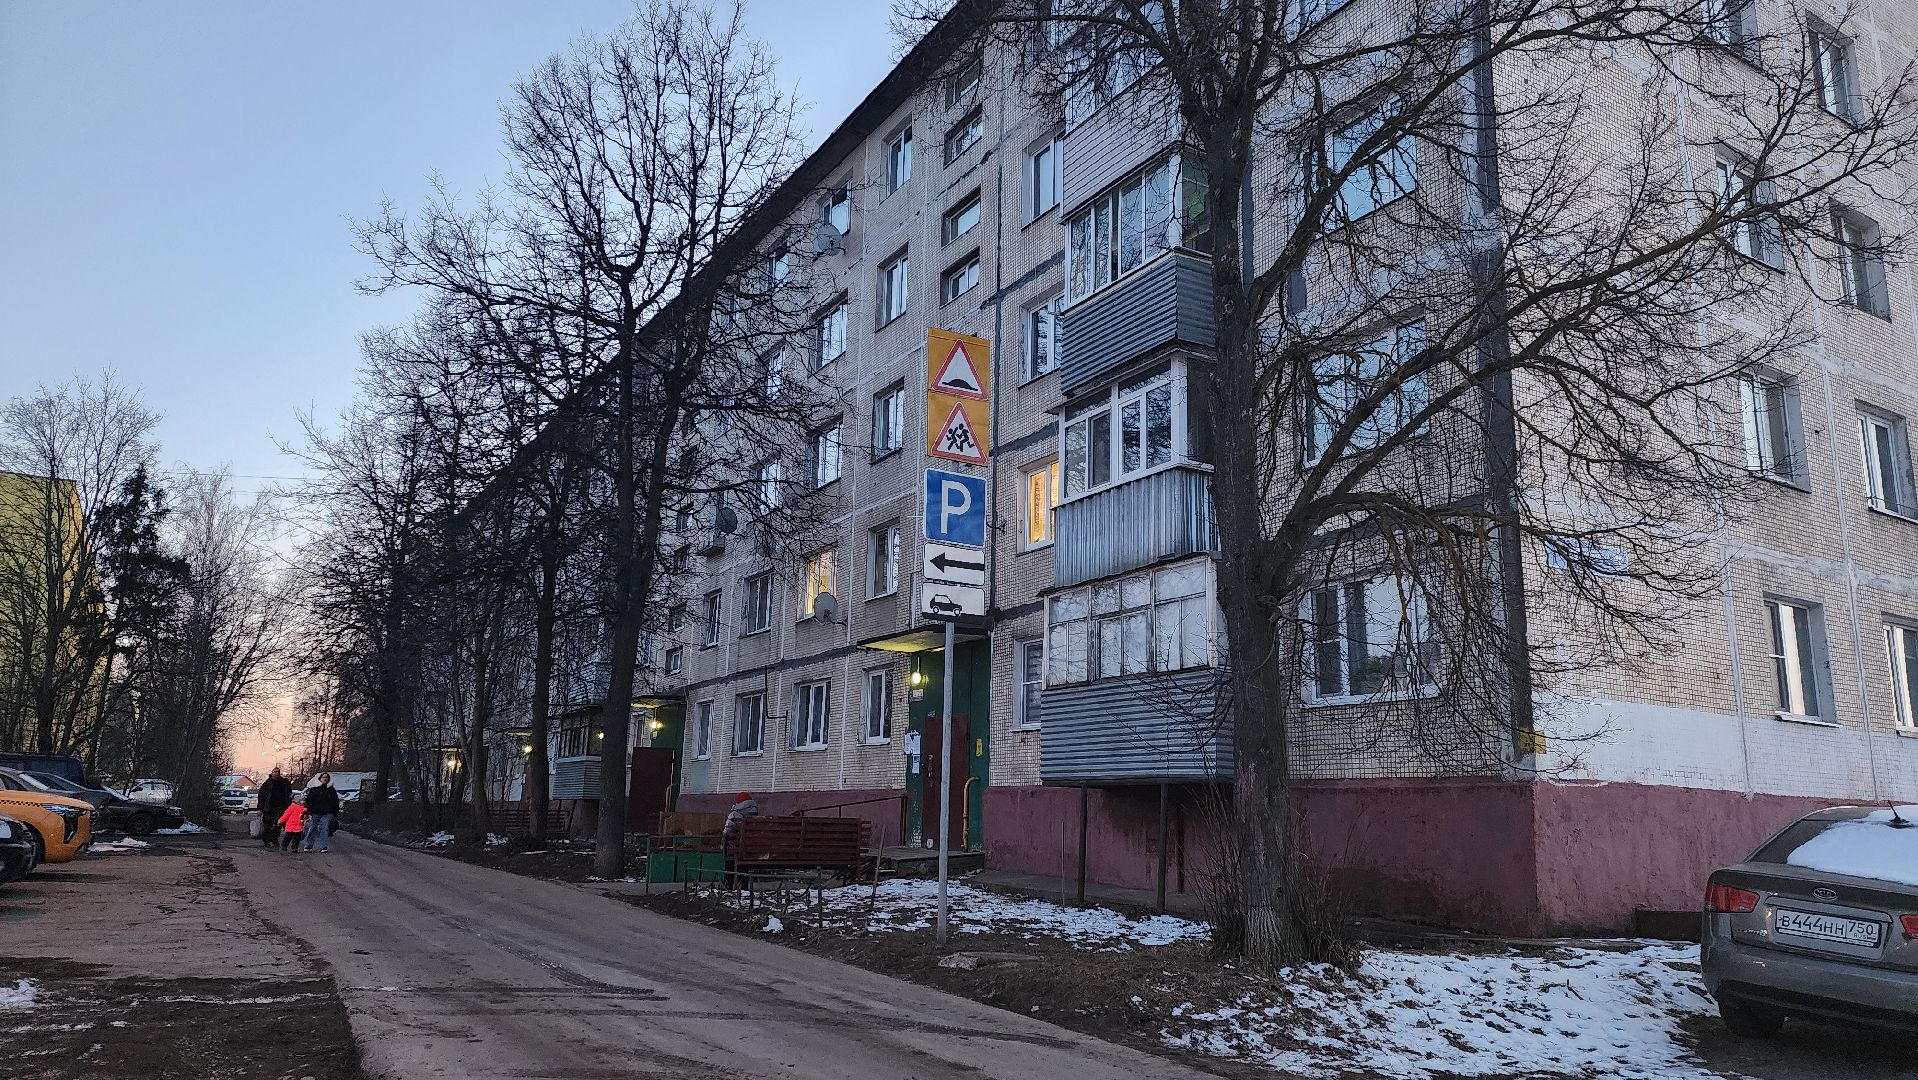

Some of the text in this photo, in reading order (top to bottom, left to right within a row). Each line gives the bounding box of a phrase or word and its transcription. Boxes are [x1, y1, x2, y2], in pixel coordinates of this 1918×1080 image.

[941, 480, 971, 534] P
[1781, 914, 1845, 936] В444НН
[1848, 921, 1875, 936] 750
